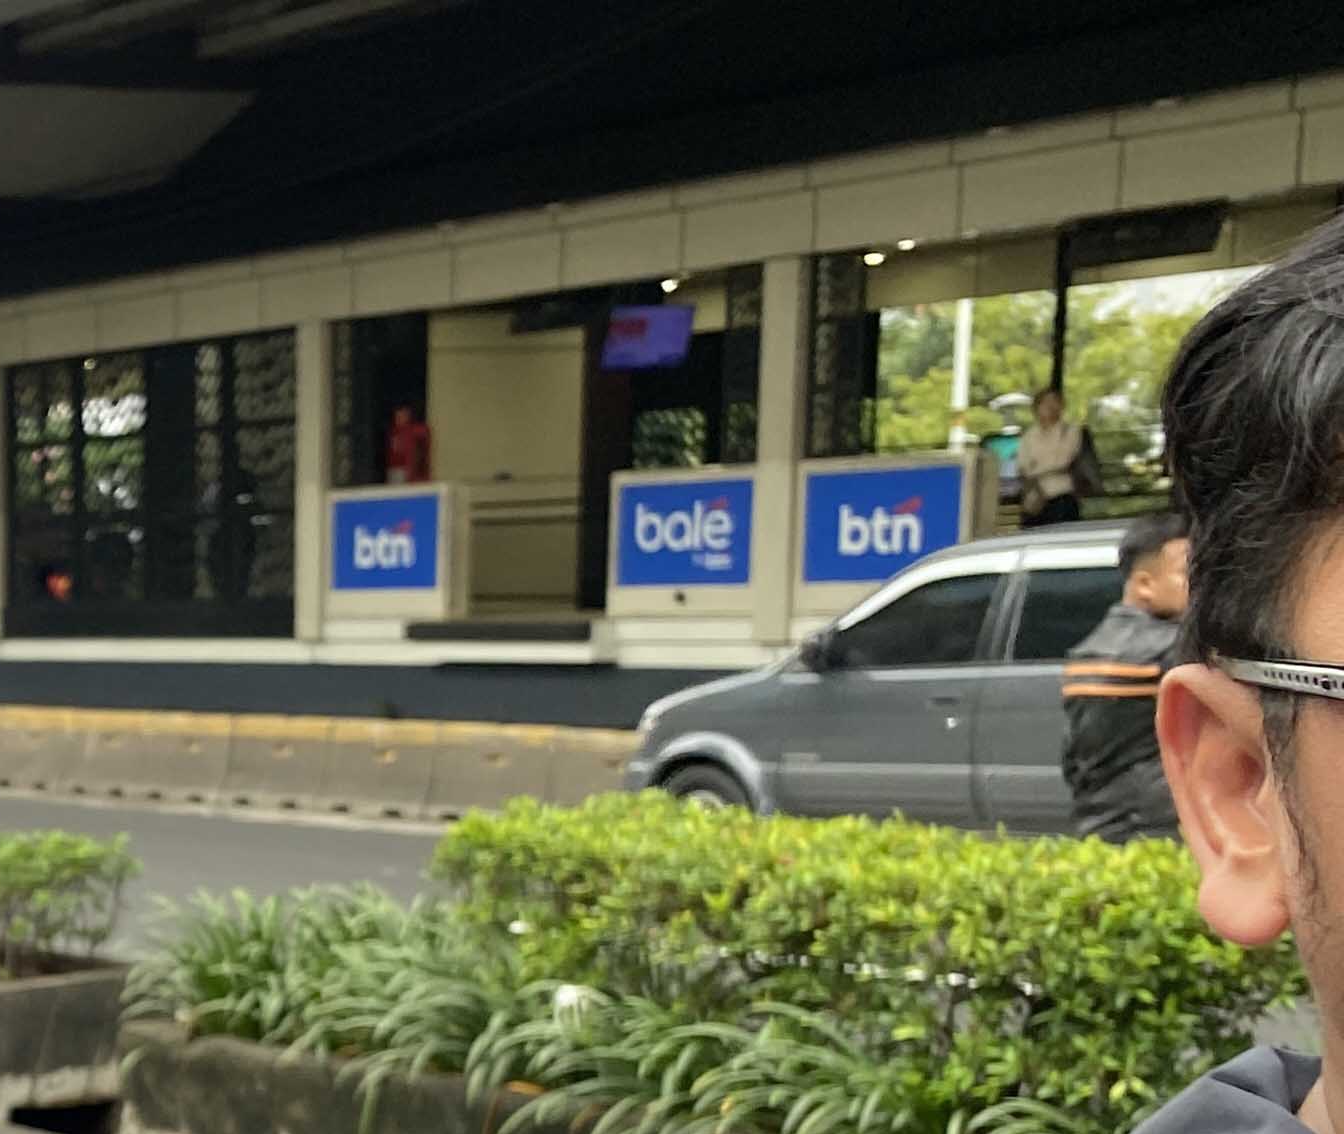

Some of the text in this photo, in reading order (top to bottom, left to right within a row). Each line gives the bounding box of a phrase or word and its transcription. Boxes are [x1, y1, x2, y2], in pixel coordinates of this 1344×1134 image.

[353, 524, 416, 569] btn
[635, 498, 734, 552] bale
[837, 504, 922, 556] btn
